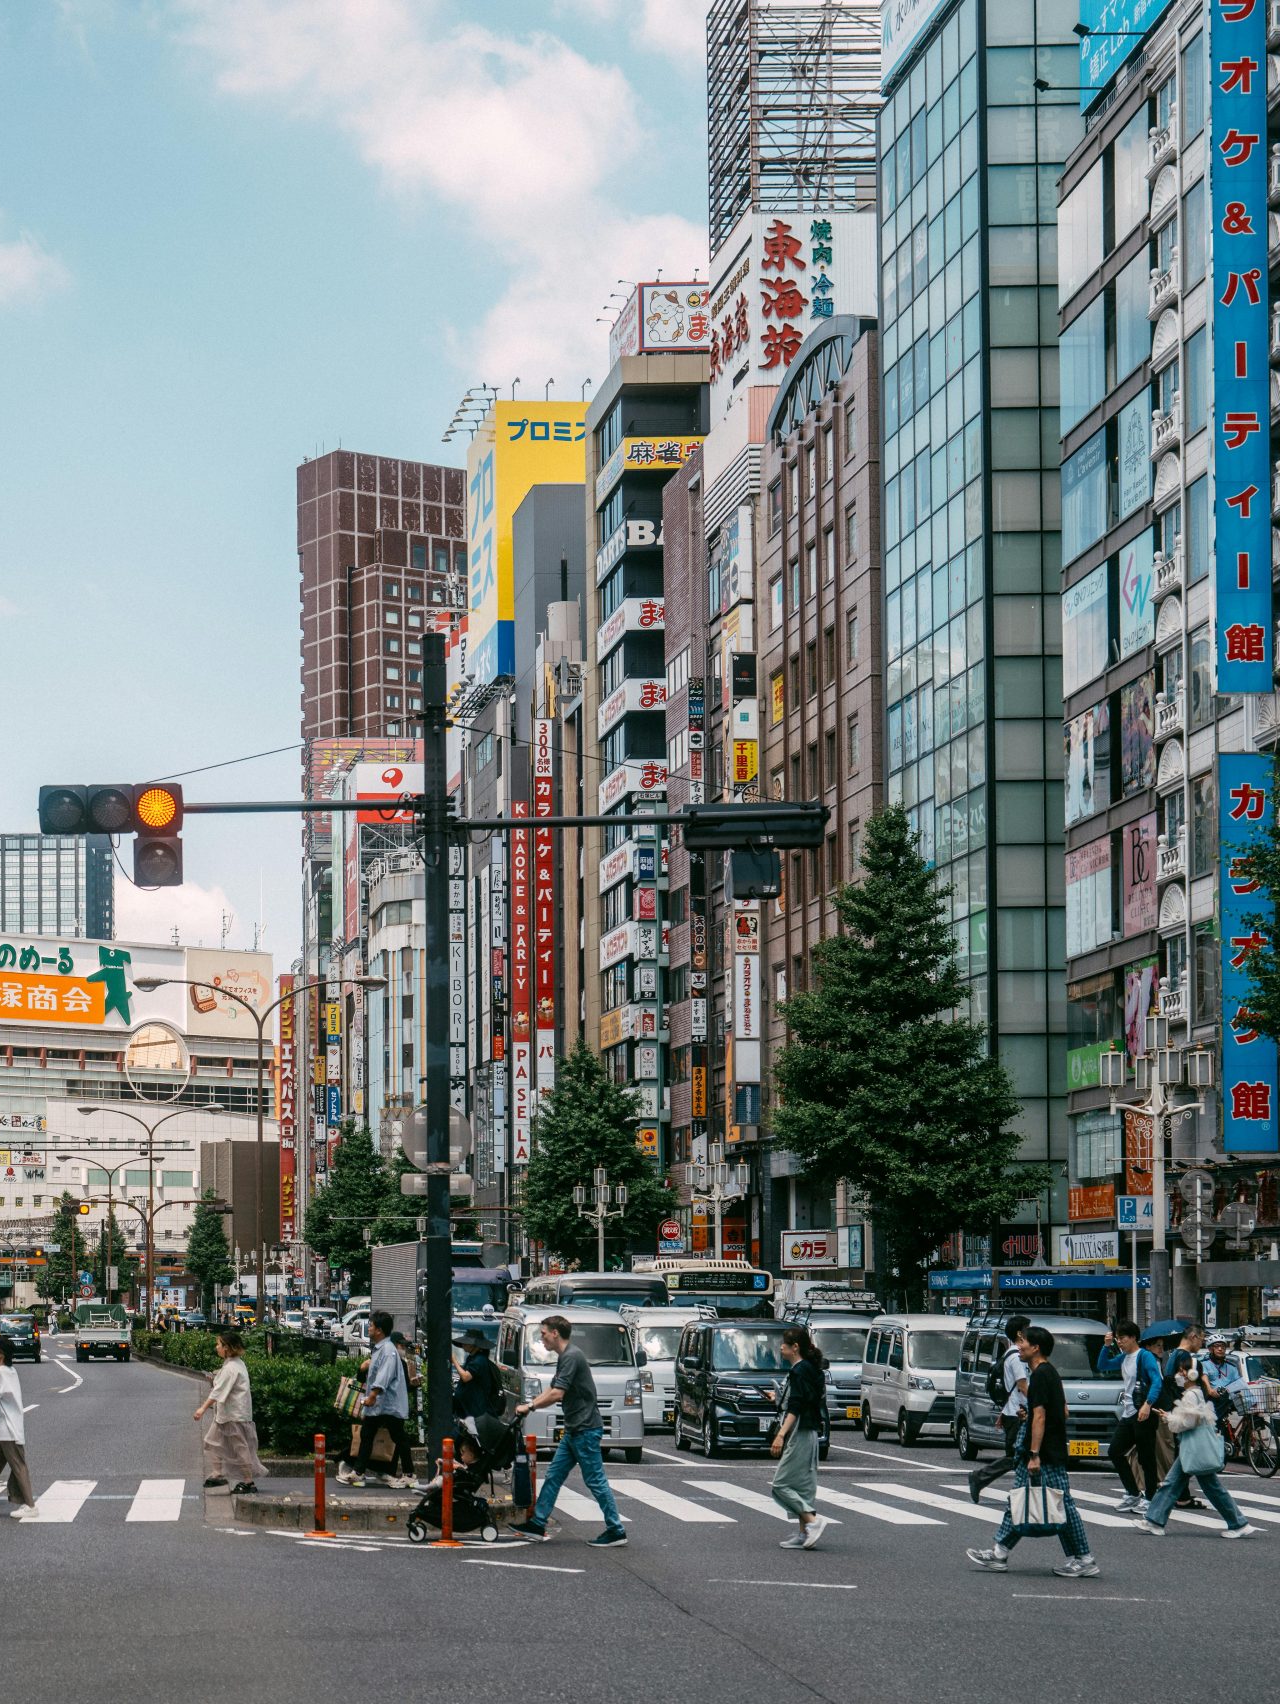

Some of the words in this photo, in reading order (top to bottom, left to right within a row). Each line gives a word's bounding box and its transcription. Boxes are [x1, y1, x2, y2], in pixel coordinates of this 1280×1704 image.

[758, 219, 809, 371] 東海苑
[596, 524, 626, 579] DARTS
[538, 722, 549, 758] 300
[536, 758, 551, 766] 名様
[536, 765, 551, 773] OK
[736, 743, 748, 780] 千里香
[515, 802, 526, 897] KRAOKE
[452, 882, 461, 906] おかか
[515, 904, 526, 915] &
[515, 924, 527, 990] PARTY
[452, 945, 463, 1040] KIBORI
[281, 985, 293, 1040] パチンコ
[692, 1035, 707, 1043] 4F
[496, 1066, 504, 1086] ZEST
[280, 1043, 294, 1149] エスパス日拓
[516, 1049, 528, 1160] PASELA
[281, 1174, 294, 1217] パチンコ
[1124, 1200, 1134, 1214] P
[1005, 1278, 1054, 1287] SUBNADE
